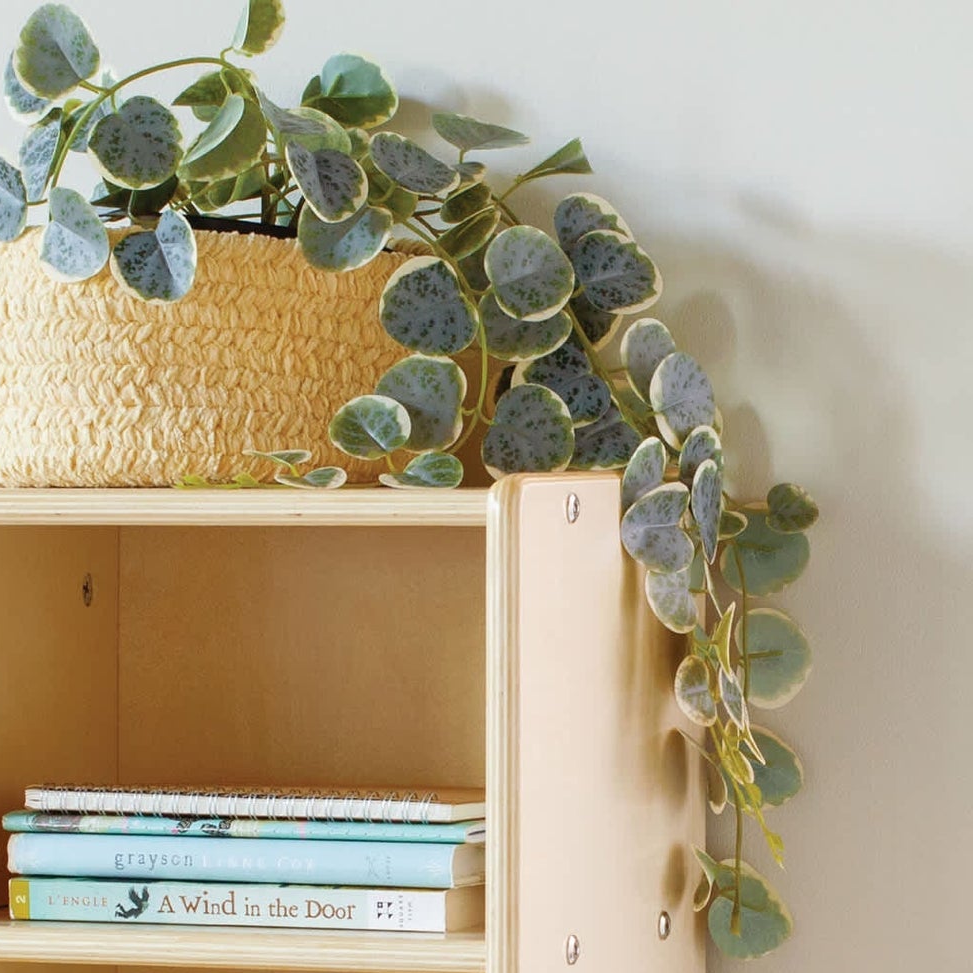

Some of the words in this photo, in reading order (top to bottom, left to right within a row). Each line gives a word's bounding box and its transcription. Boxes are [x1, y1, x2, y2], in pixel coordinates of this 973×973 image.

[115, 853, 193, 870] grayson
[16, 895, 26, 903] 2
[48, 894, 108, 908] L'ENGLE
[158, 895, 175, 913] A
[179, 891, 237, 915] Wind
[245, 897, 260, 916] in
[268, 898, 298, 917] the
[305, 899, 356, 920] Door
